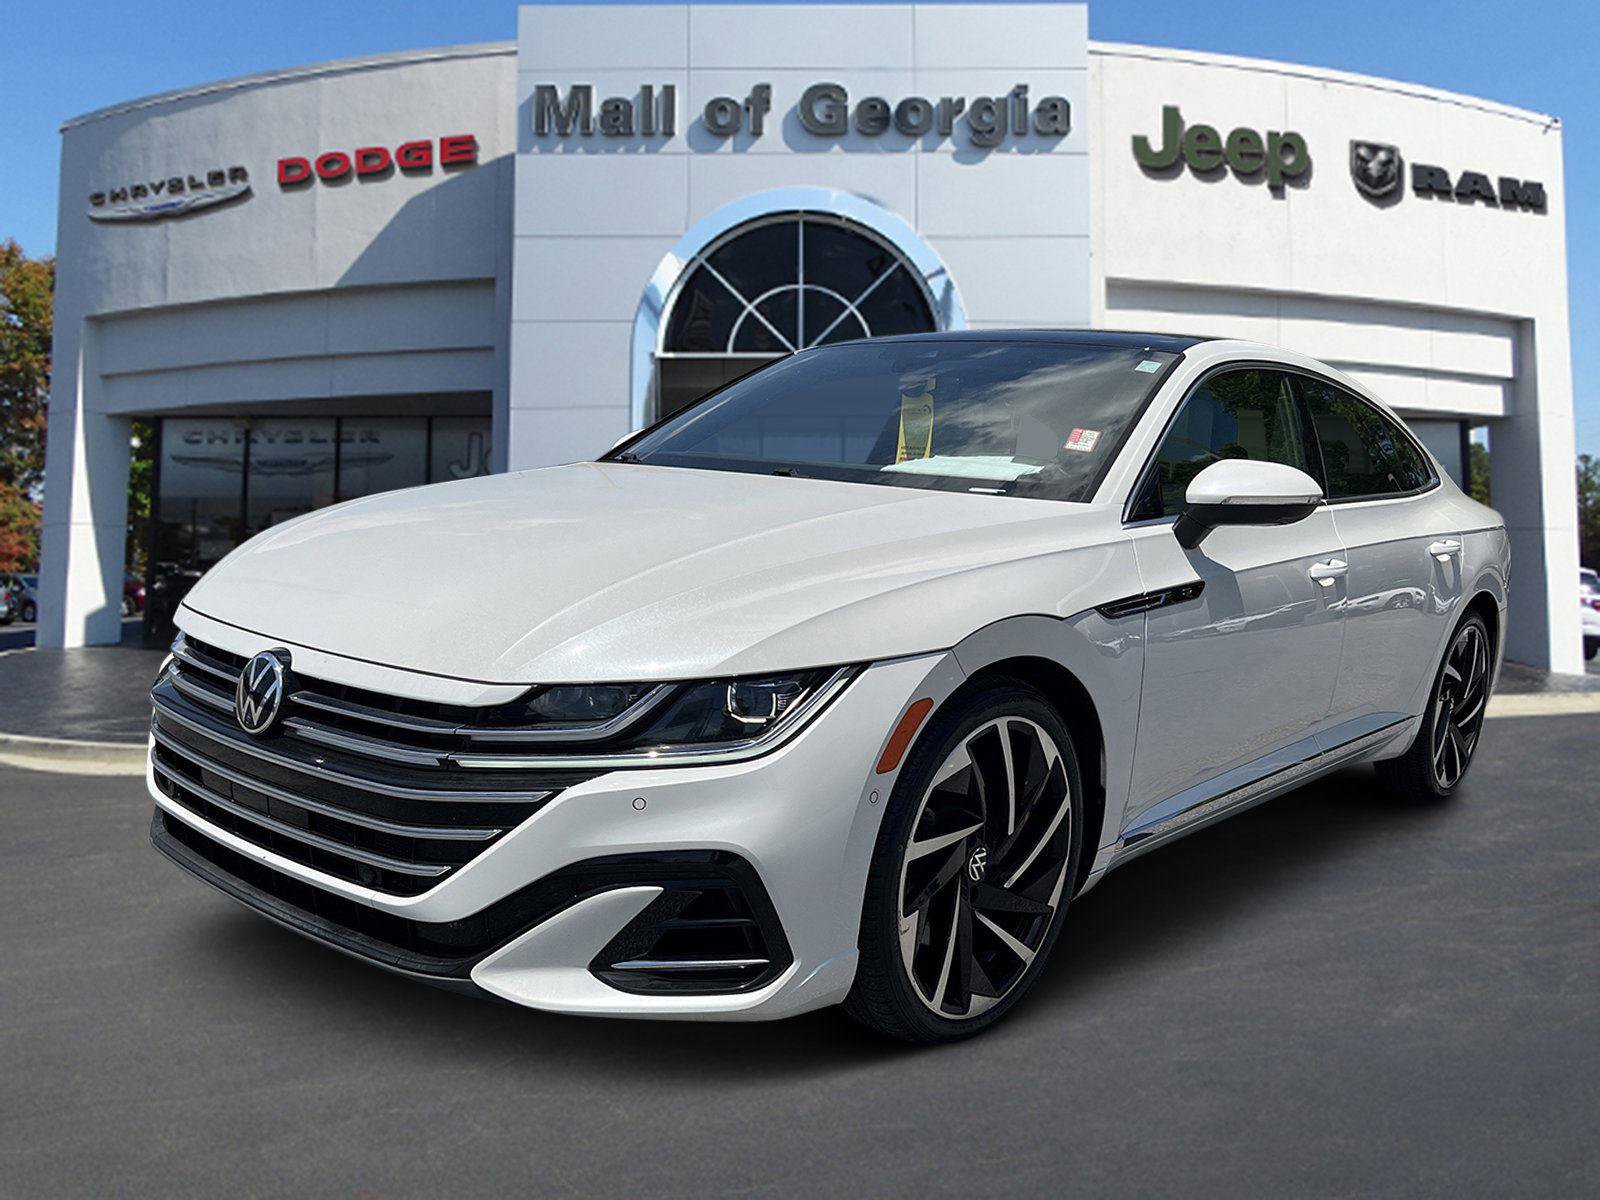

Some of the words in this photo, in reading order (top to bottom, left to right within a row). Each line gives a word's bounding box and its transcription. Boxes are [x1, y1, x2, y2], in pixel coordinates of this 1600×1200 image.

[532, 84, 676, 136] Mall
[702, 83, 771, 136] of
[798, 82, 1072, 148] Georgia
[277, 134, 476, 185] DODGE
[1132, 105, 1308, 190] Jeep
[89, 165, 249, 207] CHRYSLER
[1410, 163, 1547, 213] RAM
